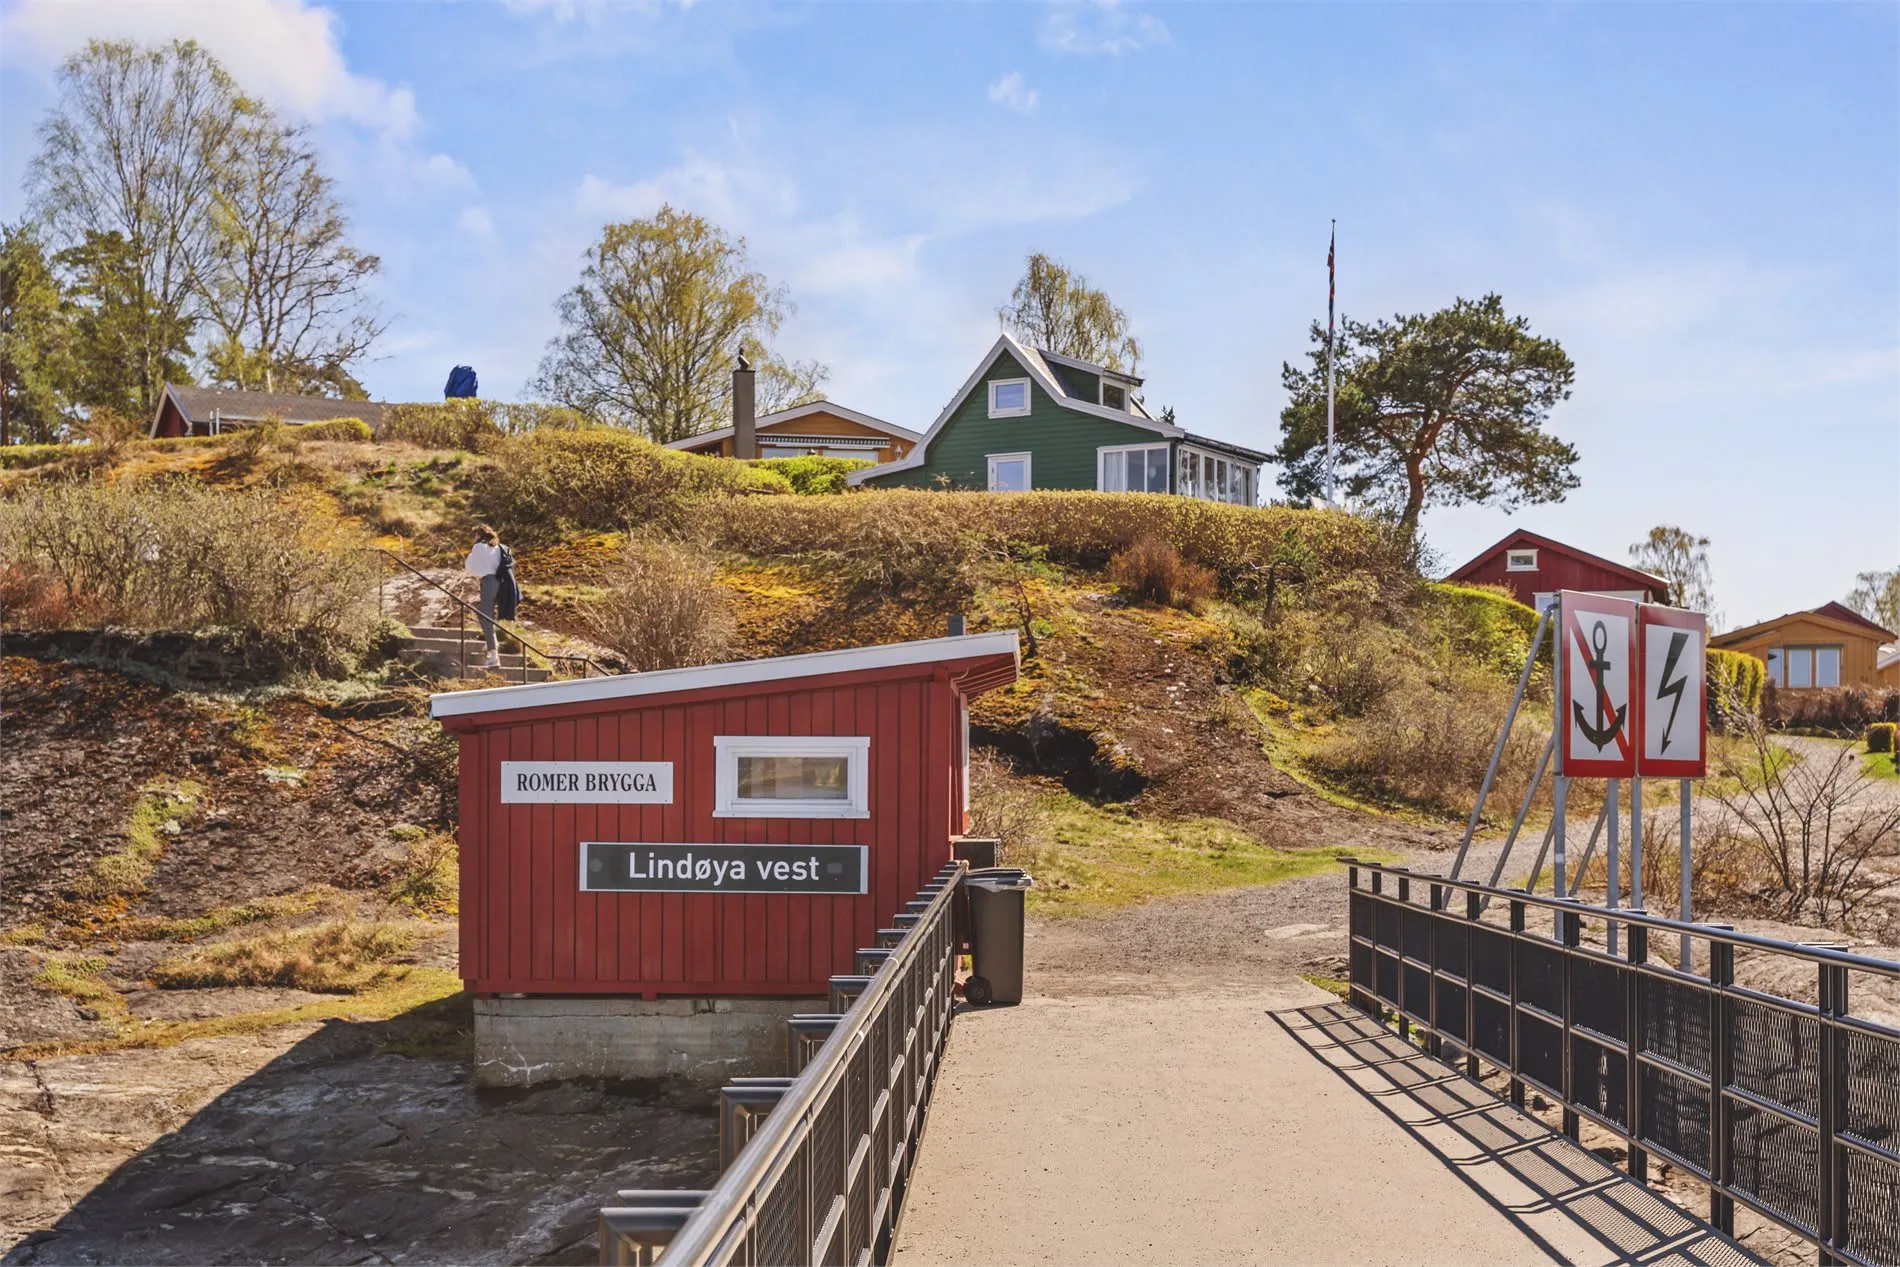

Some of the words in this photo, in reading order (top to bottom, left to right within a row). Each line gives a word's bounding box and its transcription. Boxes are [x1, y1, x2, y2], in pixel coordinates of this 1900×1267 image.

[516, 773, 579, 792] ROMER
[585, 773, 657, 792] BRYGGA
[628, 852, 746, 886] Lindøya
[756, 856, 820, 881] vest
